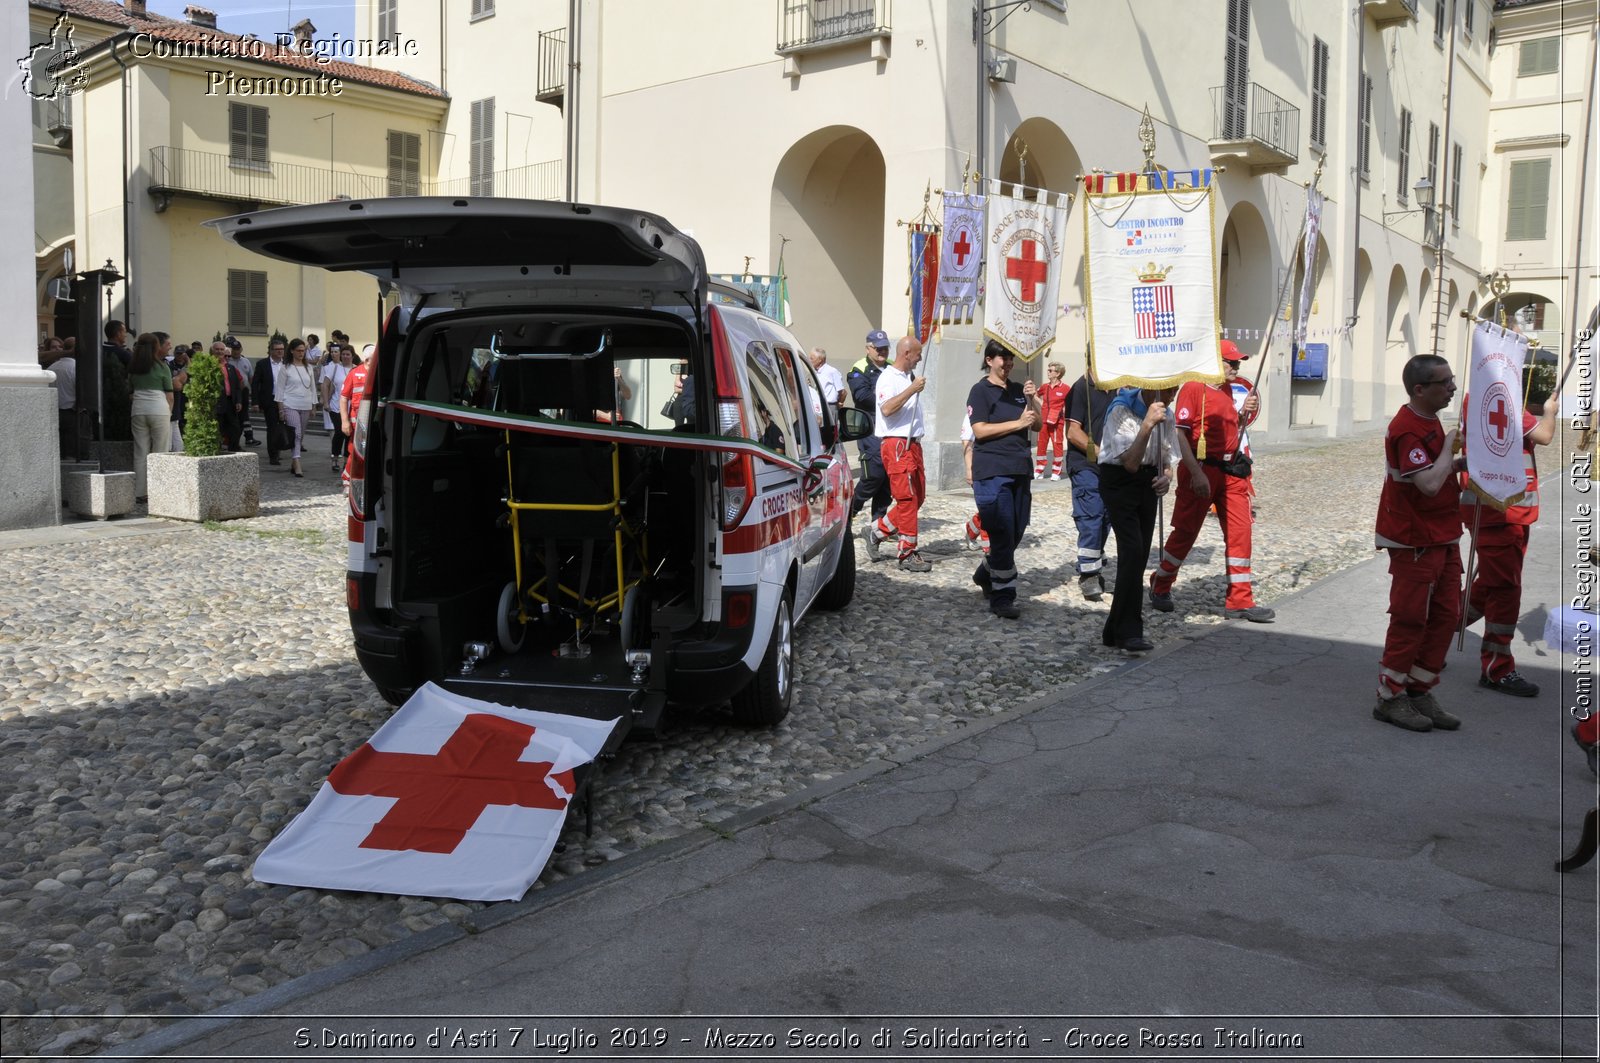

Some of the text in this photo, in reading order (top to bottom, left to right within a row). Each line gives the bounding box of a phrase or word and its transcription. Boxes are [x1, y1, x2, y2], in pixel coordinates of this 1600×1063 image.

[992, 213, 1014, 244] CROCE
[1117, 217, 1184, 230] CENTRO INCONTRO
[1119, 342, 1192, 355] SAN DAMIANO D'ASTI
[1479, 470, 1498, 481] Gruppo
[762, 494, 785, 518] CROCE
